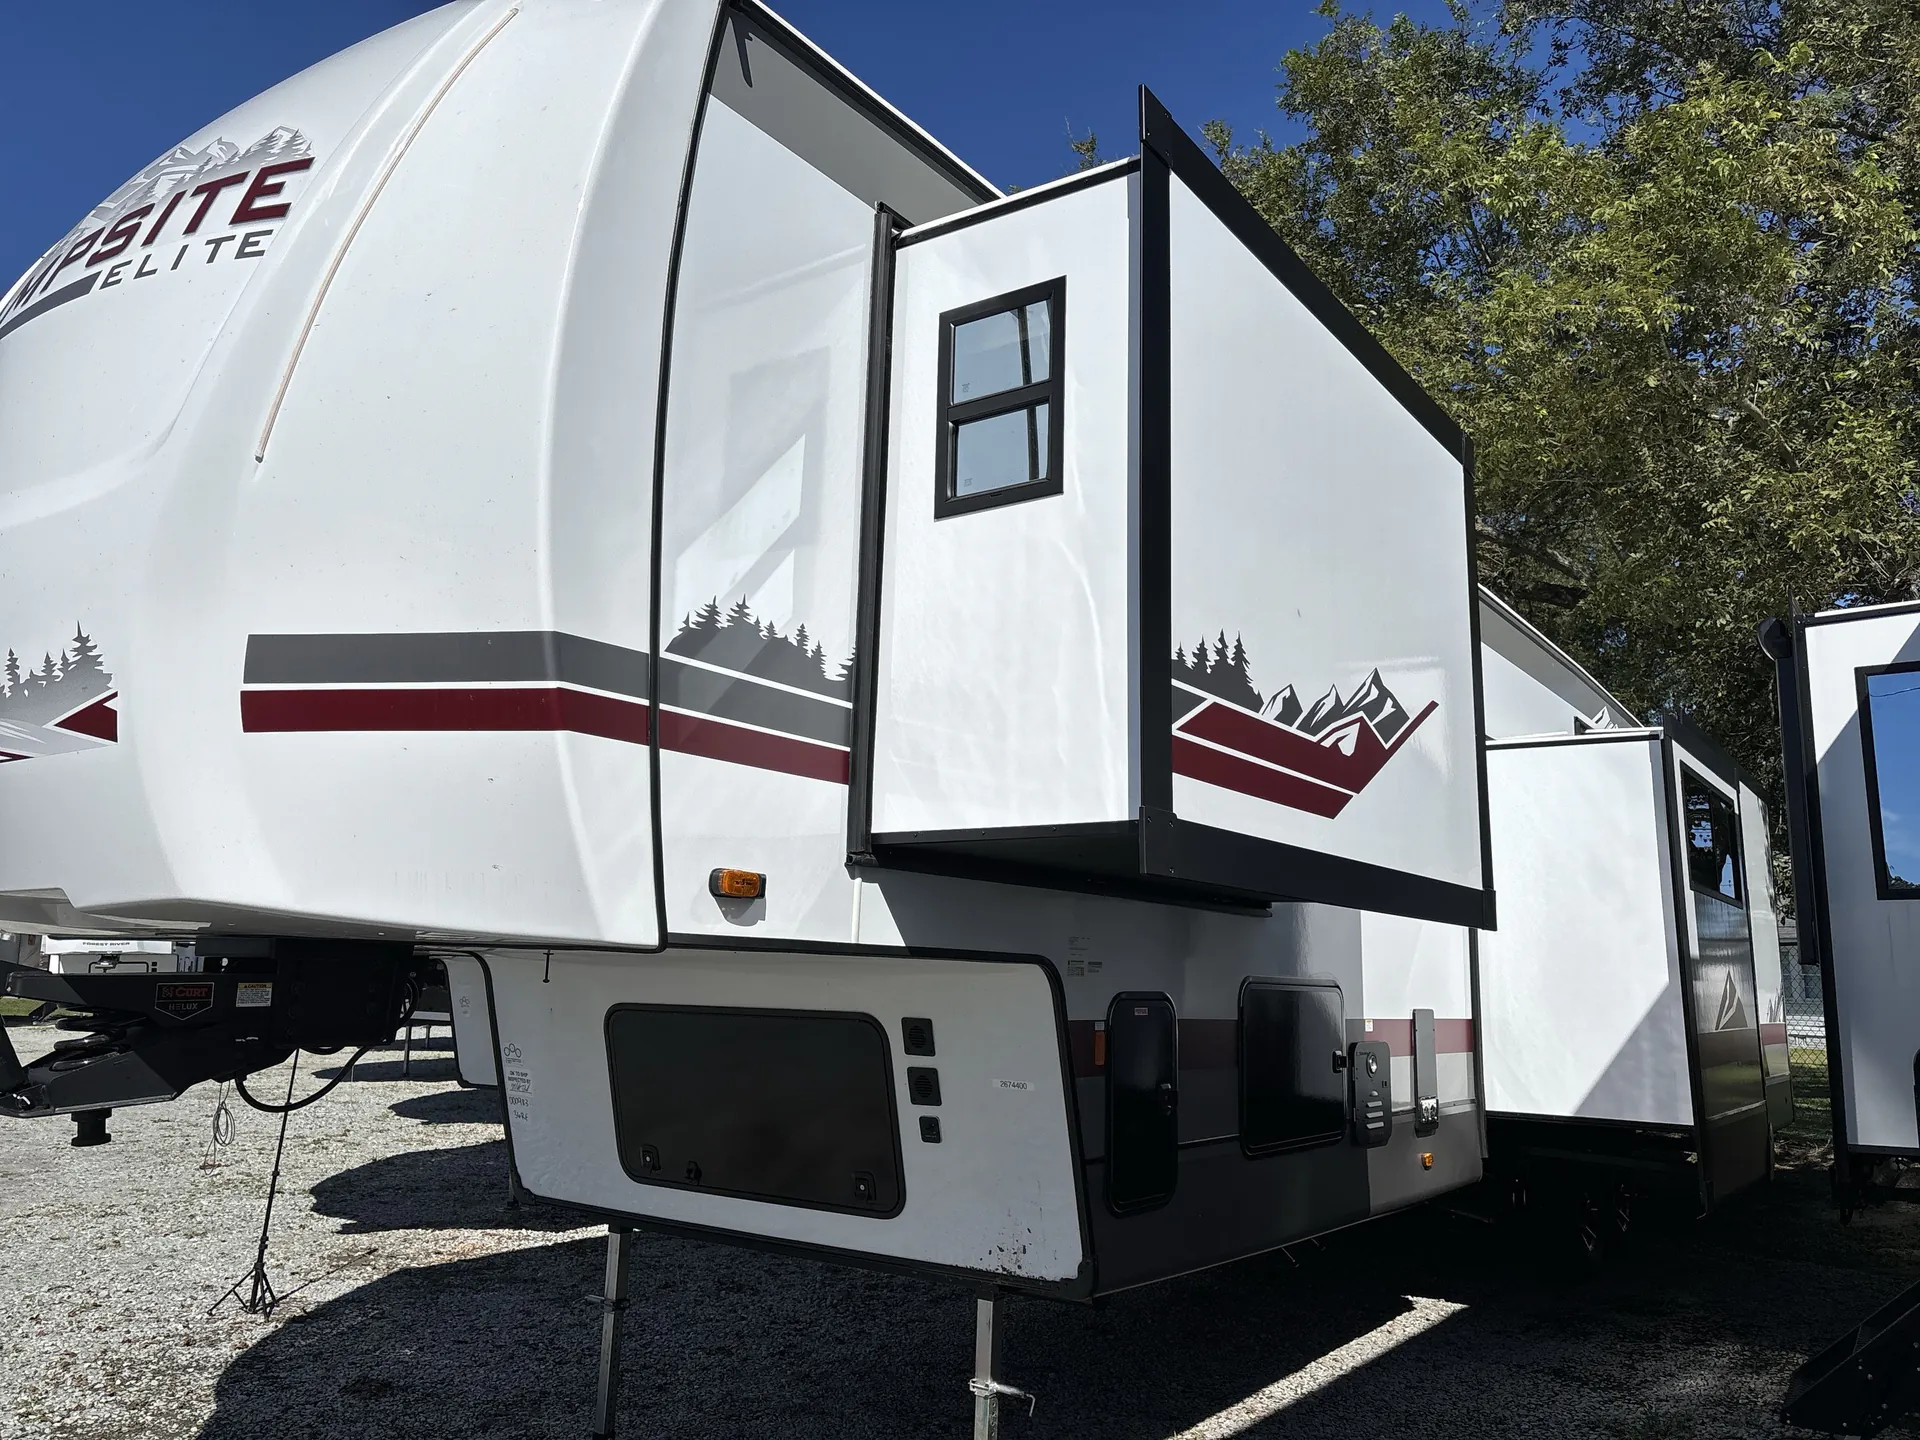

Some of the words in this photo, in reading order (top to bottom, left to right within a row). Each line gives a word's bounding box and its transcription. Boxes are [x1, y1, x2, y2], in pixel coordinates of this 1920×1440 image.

[99, 229, 274, 290] ELITE
[176, 986, 208, 997] CURT
[169, 1002, 198, 1011] HELUX
[1000, 1080, 1028, 1090] 2674400
